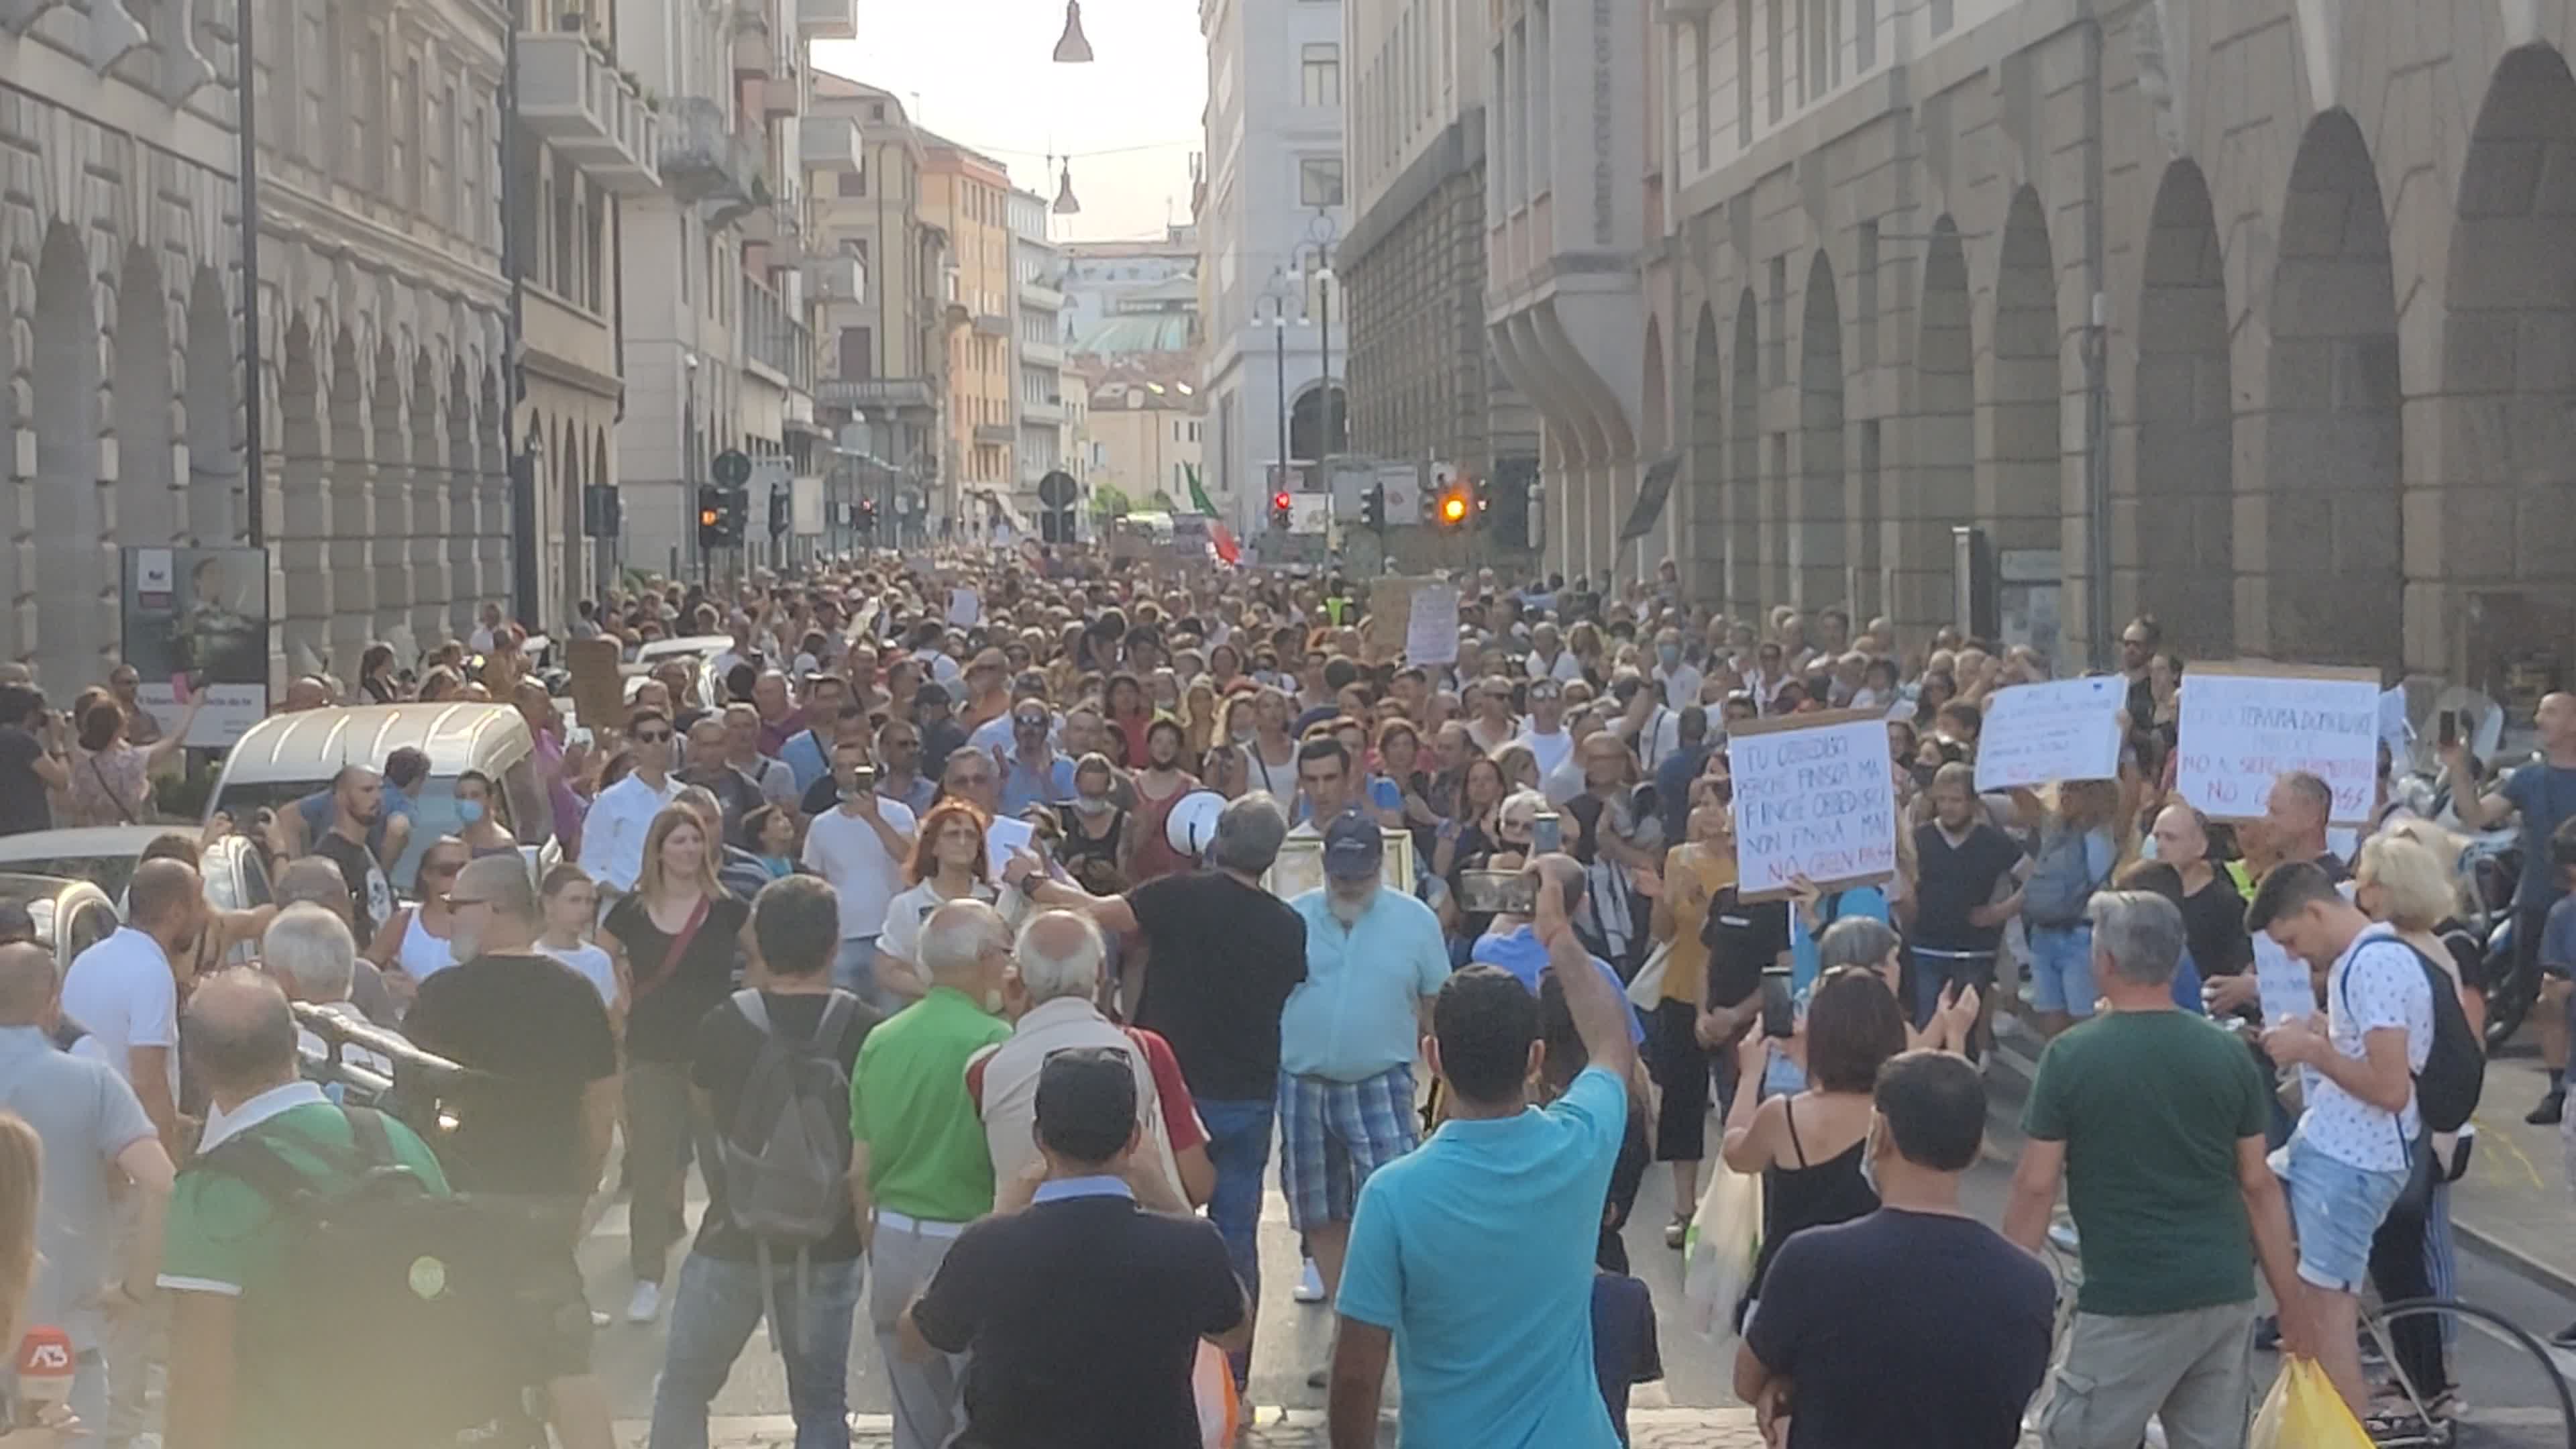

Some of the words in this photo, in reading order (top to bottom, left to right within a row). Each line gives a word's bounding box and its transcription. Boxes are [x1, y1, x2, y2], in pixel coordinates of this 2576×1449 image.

[1746, 745, 1768, 772] TU
[1857, 757, 1882, 780] MA
[2182, 752, 2212, 775] NO
[2206, 776, 2239, 804] NO
[1746, 832, 1782, 858] NON
[1766, 853, 1801, 884] NO
